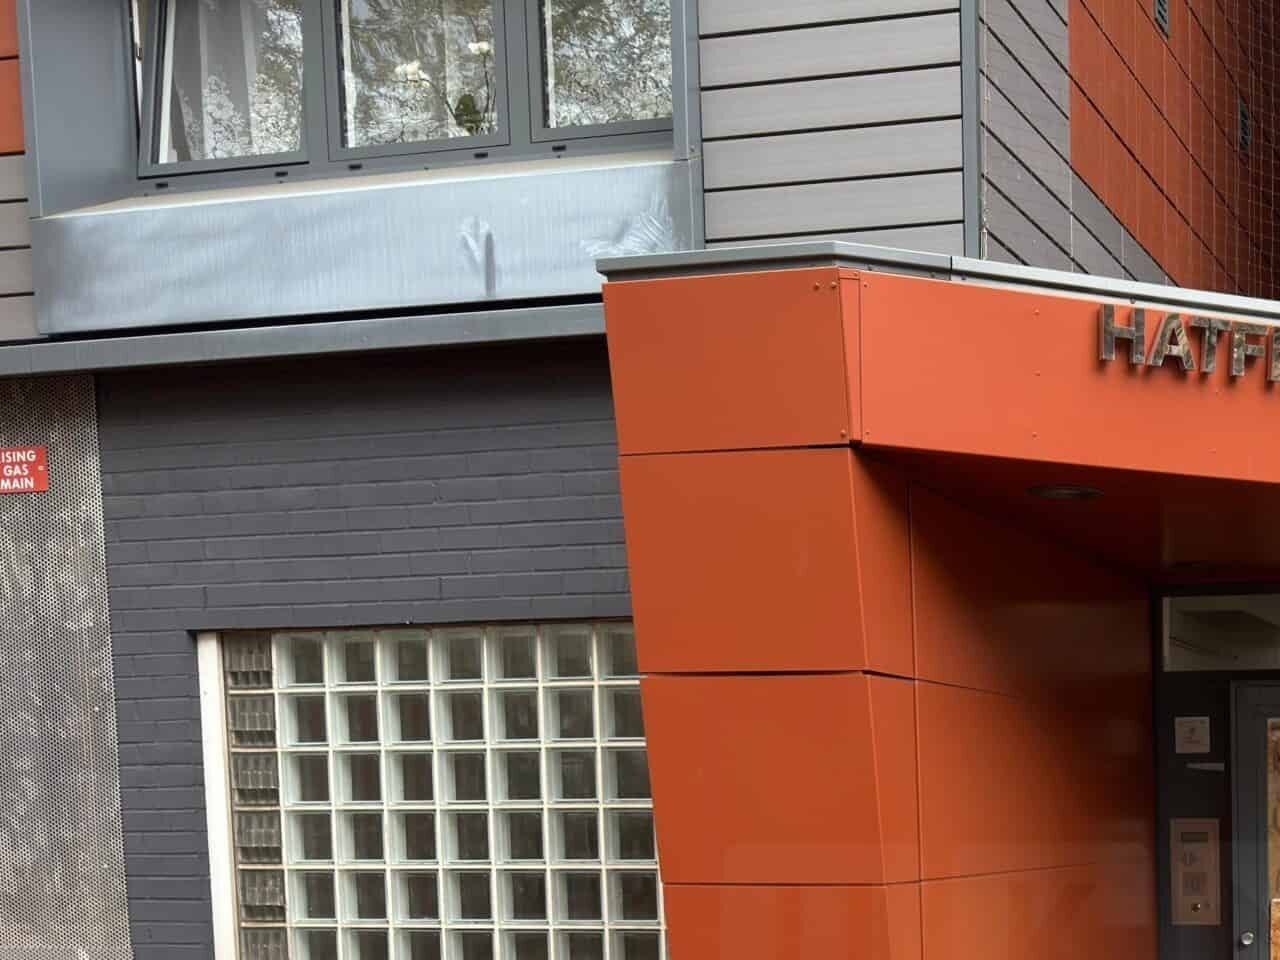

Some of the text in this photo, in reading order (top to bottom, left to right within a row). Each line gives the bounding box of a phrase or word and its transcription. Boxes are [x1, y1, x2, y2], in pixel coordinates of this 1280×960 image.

[0, 450, 37, 463] ISING
[3, 464, 29, 476] GAS
[0, 477, 34, 489] MAIN
